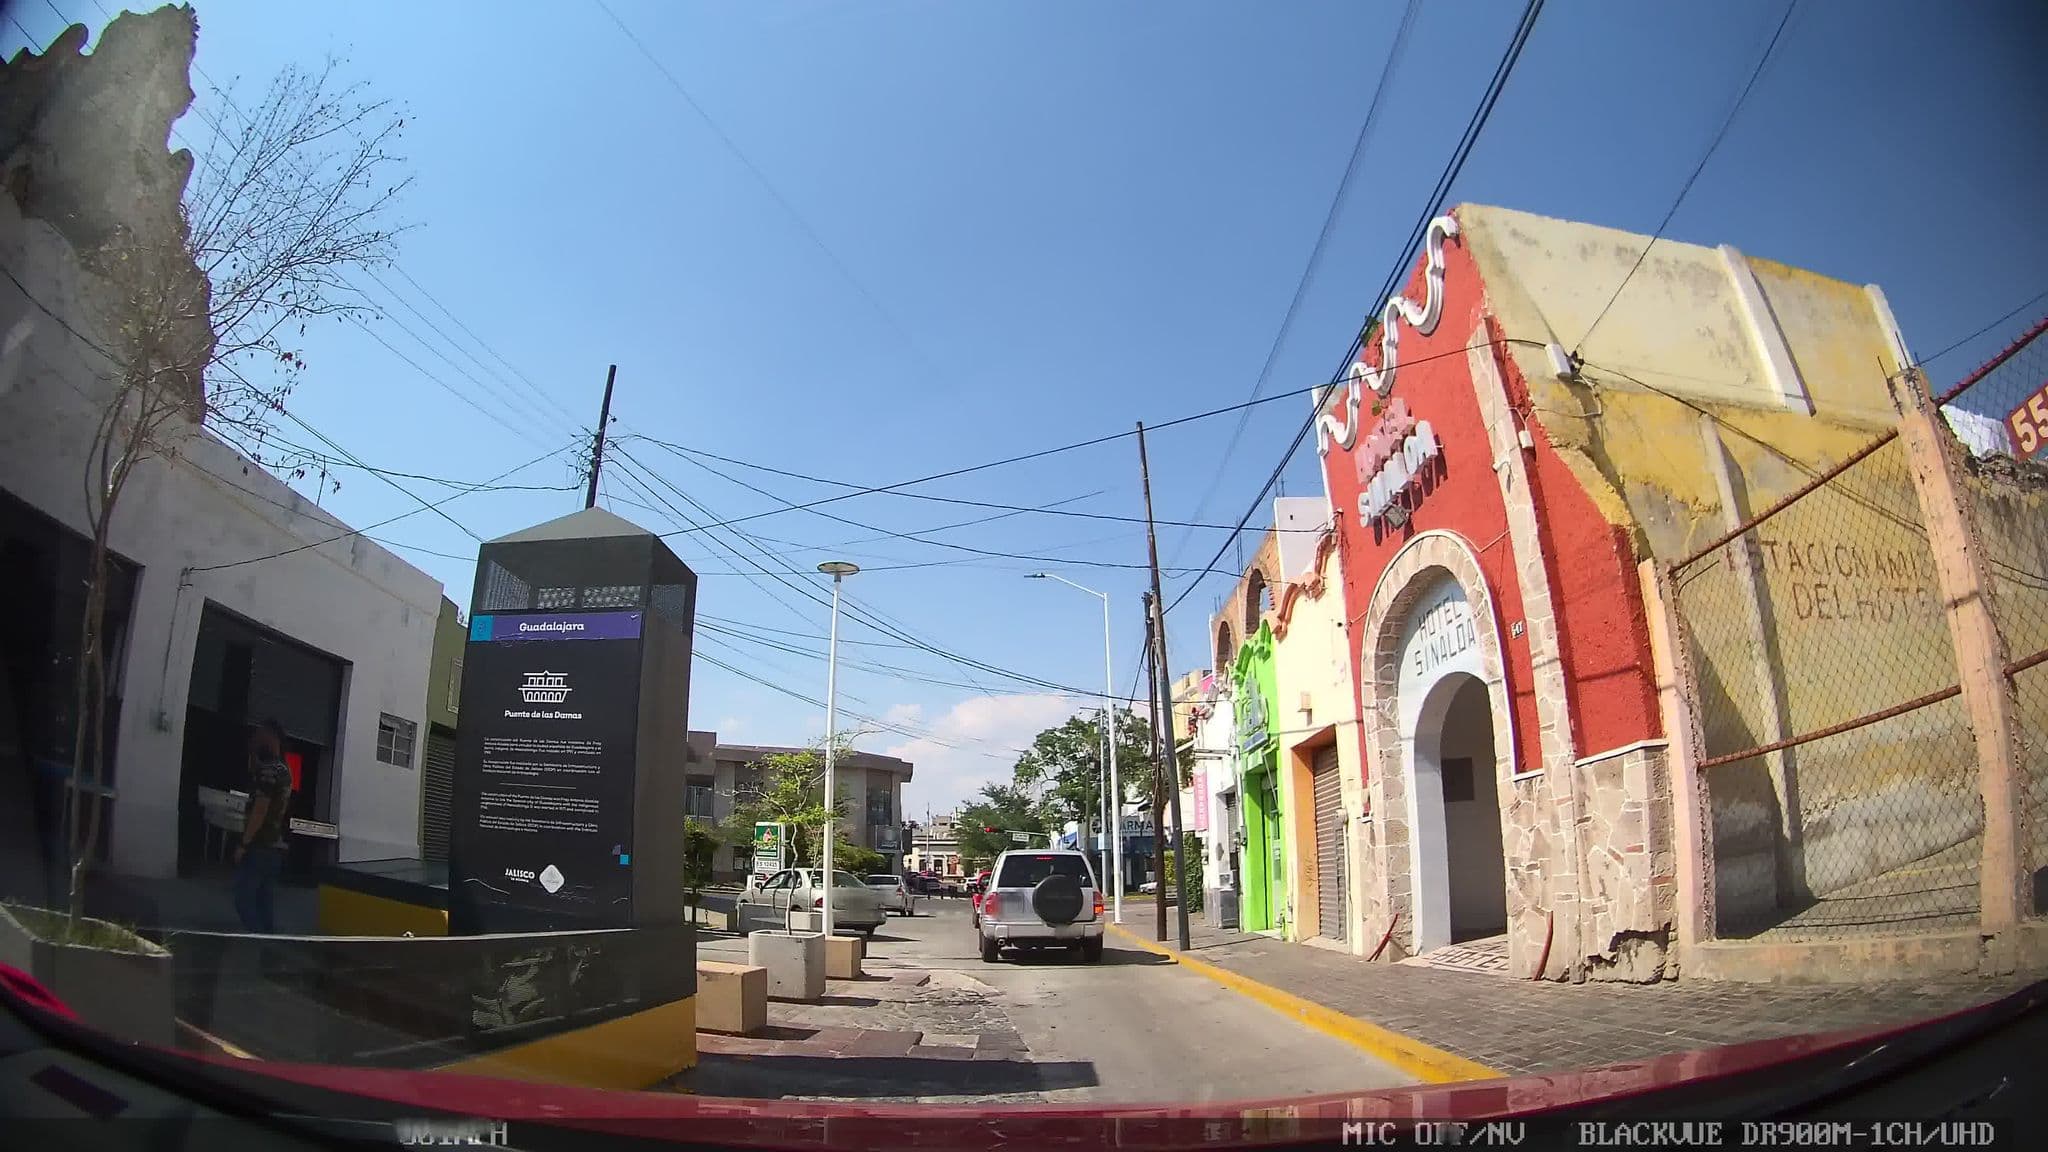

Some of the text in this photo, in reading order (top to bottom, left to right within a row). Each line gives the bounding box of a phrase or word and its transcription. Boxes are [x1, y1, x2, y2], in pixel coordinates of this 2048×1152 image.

[2011, 383, 2048, 453] 55
[1418, 592, 1462, 641] HOTEL
[519, 621, 585, 633] Guadalajara
[504, 710, 582, 719] Puente de las Damas
[505, 868, 535, 880] JALISCO
